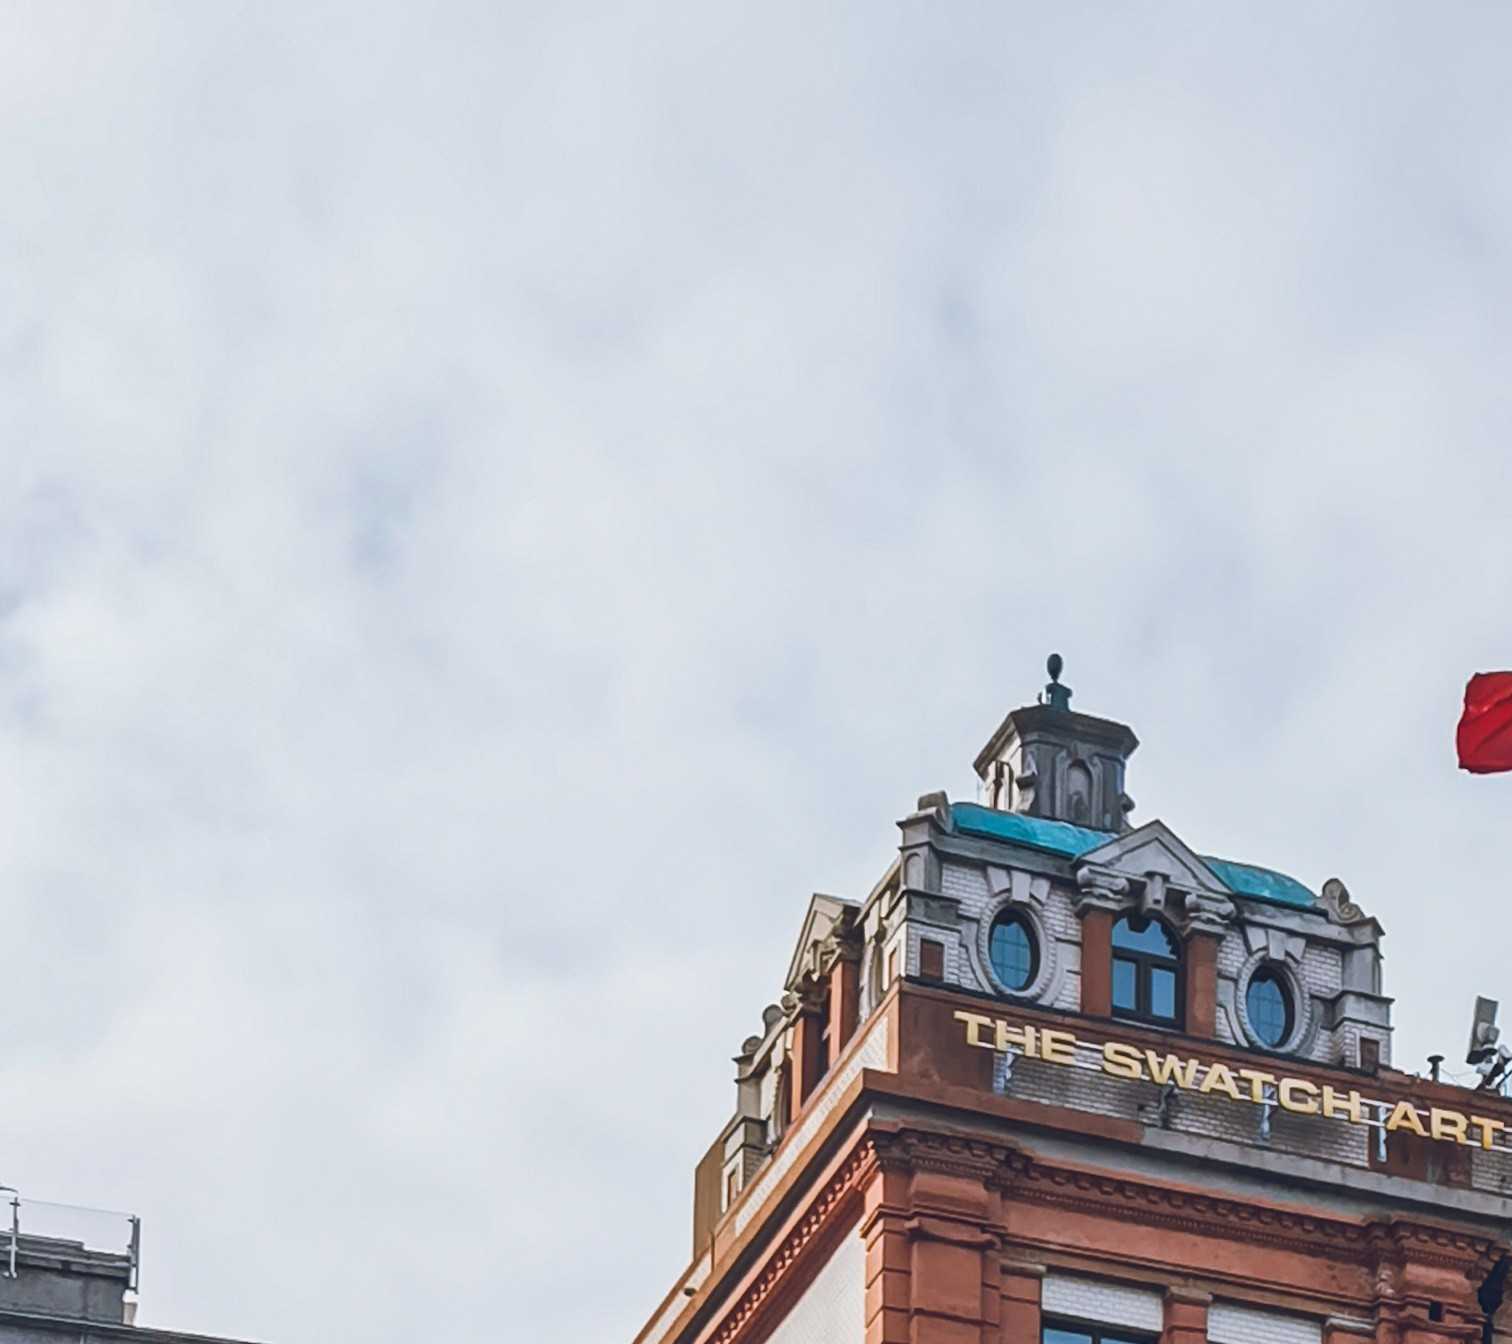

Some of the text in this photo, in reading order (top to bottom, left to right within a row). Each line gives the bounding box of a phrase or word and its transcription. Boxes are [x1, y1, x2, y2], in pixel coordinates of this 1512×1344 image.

[953, 1010, 1076, 1065] THE
[1102, 1041, 1361, 1123] SWATCH
[1386, 1101, 1505, 1150] ART
